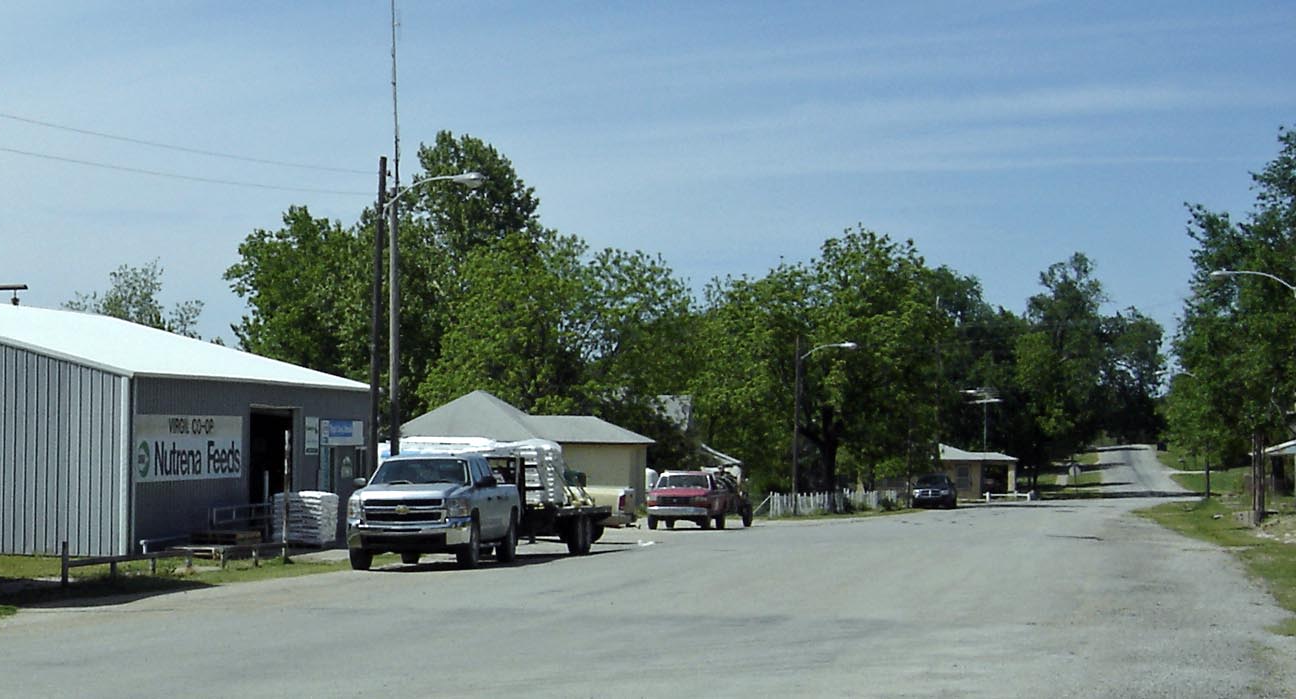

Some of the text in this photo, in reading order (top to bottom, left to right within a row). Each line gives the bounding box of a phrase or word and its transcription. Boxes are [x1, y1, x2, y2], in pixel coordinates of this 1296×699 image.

[168, 418, 214, 434] VIRGIL CO-OP
[154, 440, 241, 476] Nutrena Feeds
